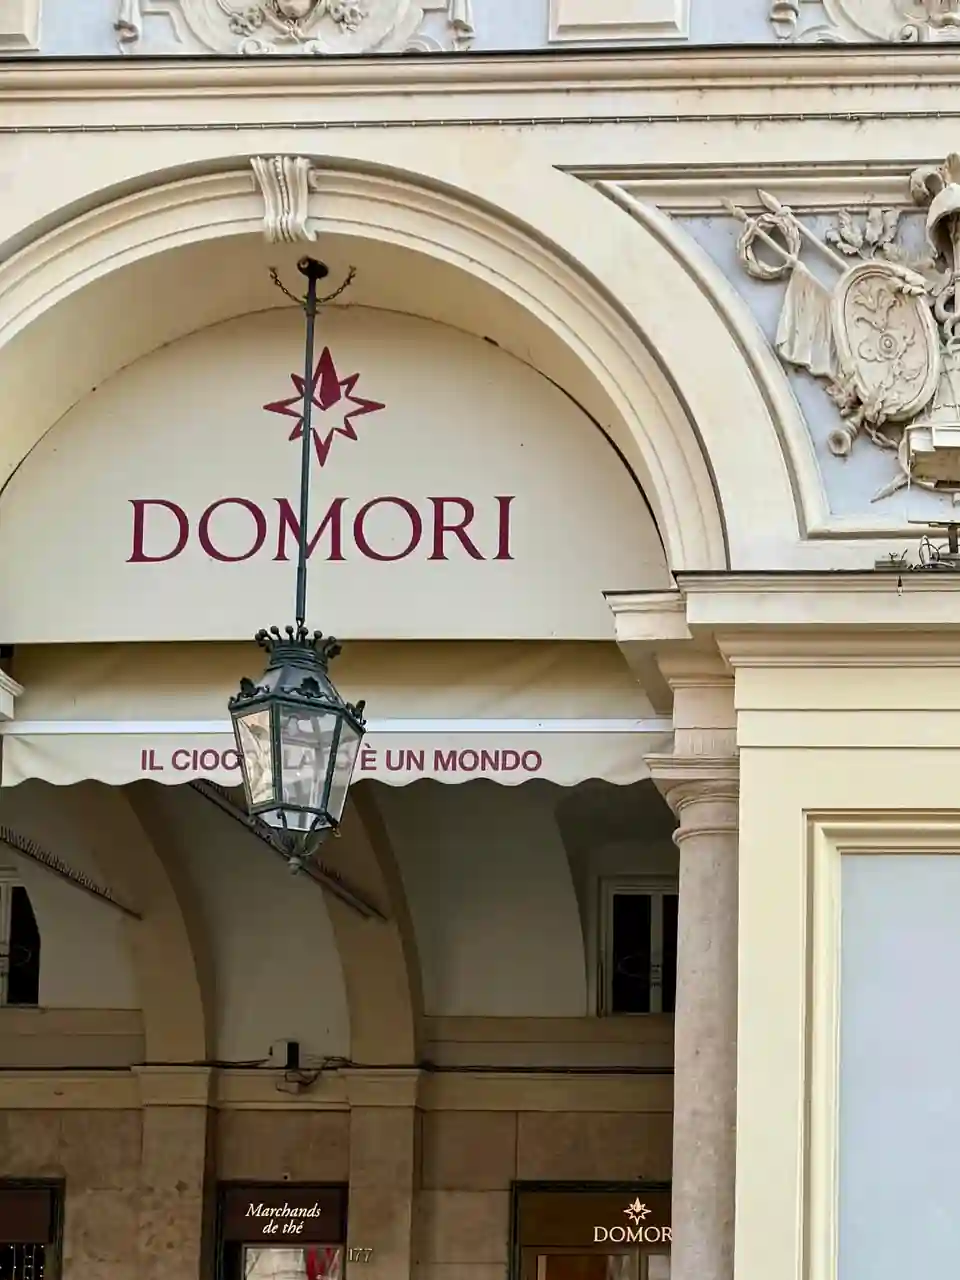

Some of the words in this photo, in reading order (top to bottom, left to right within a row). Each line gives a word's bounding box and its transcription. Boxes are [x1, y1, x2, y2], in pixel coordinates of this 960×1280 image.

[126, 495, 516, 563] DOMORI
[141, 749, 164, 771] IL
[360, 742, 377, 771] È
[386, 749, 425, 771] UN
[433, 749, 543, 772] MONDO
[245, 1201, 321, 1218] Marchands
[262, 1218, 279, 1235] de
[282, 1218, 305, 1235] thé
[593, 1226, 673, 1243] DOMOR
[347, 1247, 373, 1262] 177
